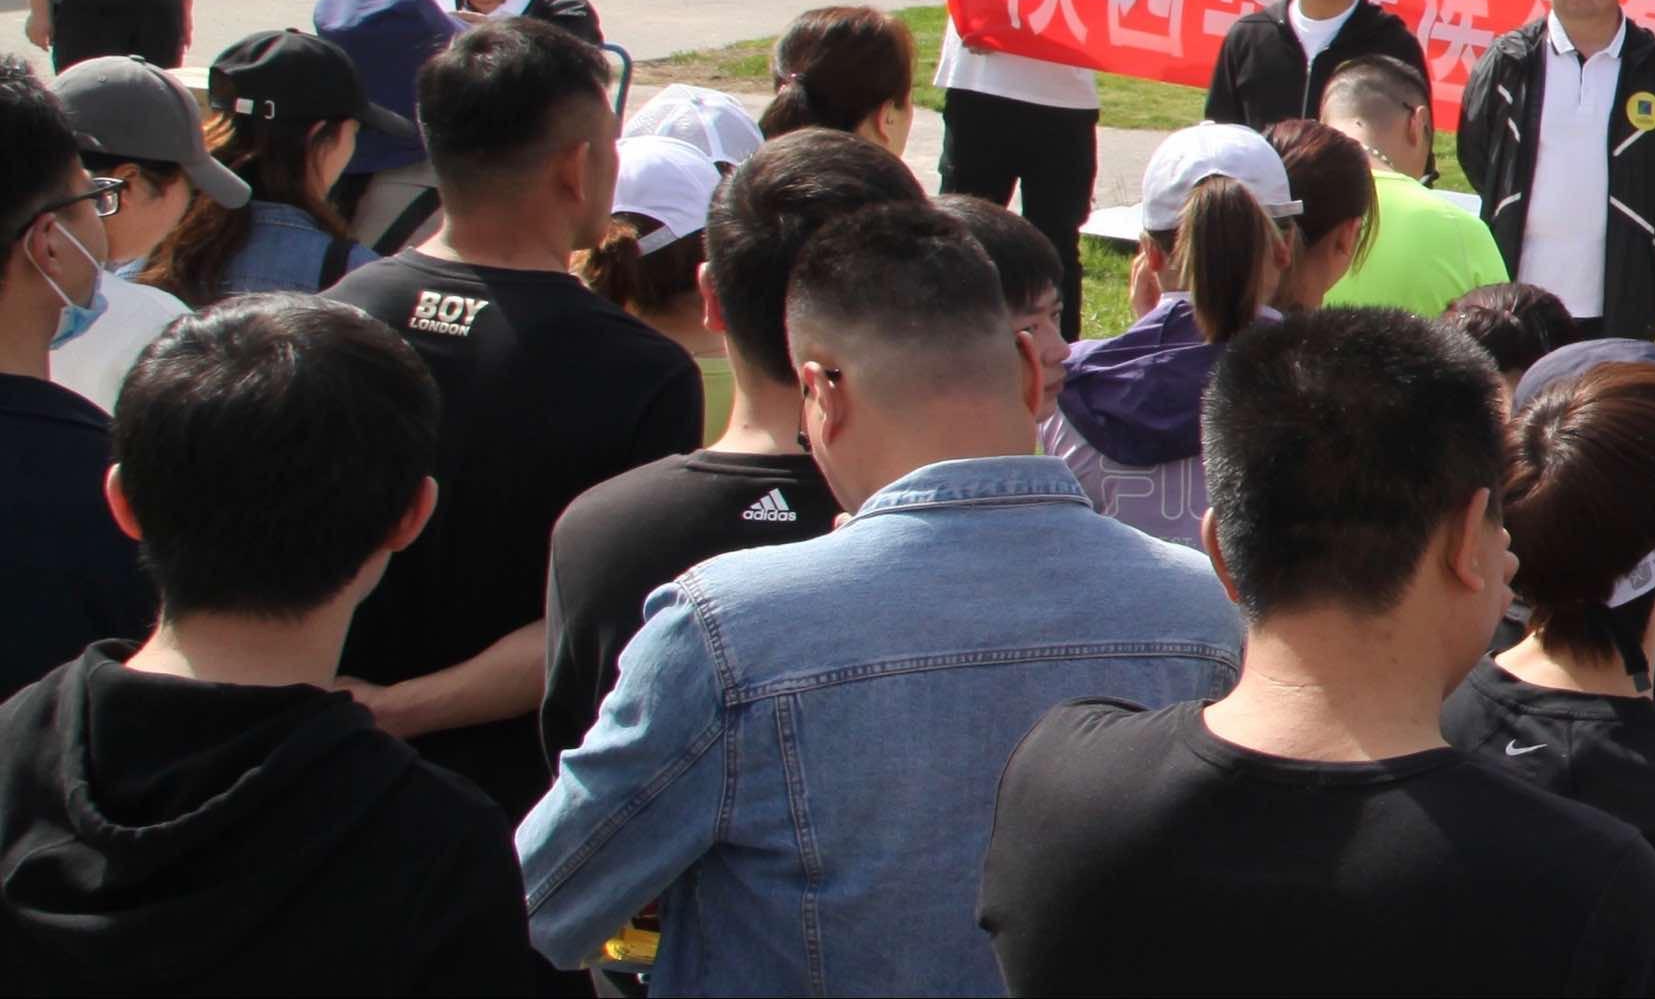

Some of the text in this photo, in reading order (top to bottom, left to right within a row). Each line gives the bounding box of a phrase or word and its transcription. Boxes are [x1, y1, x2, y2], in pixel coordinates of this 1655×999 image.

[415, 290, 489, 325] BOY
[410, 317, 470, 336] LONDON
[742, 508, 797, 521] adidas
